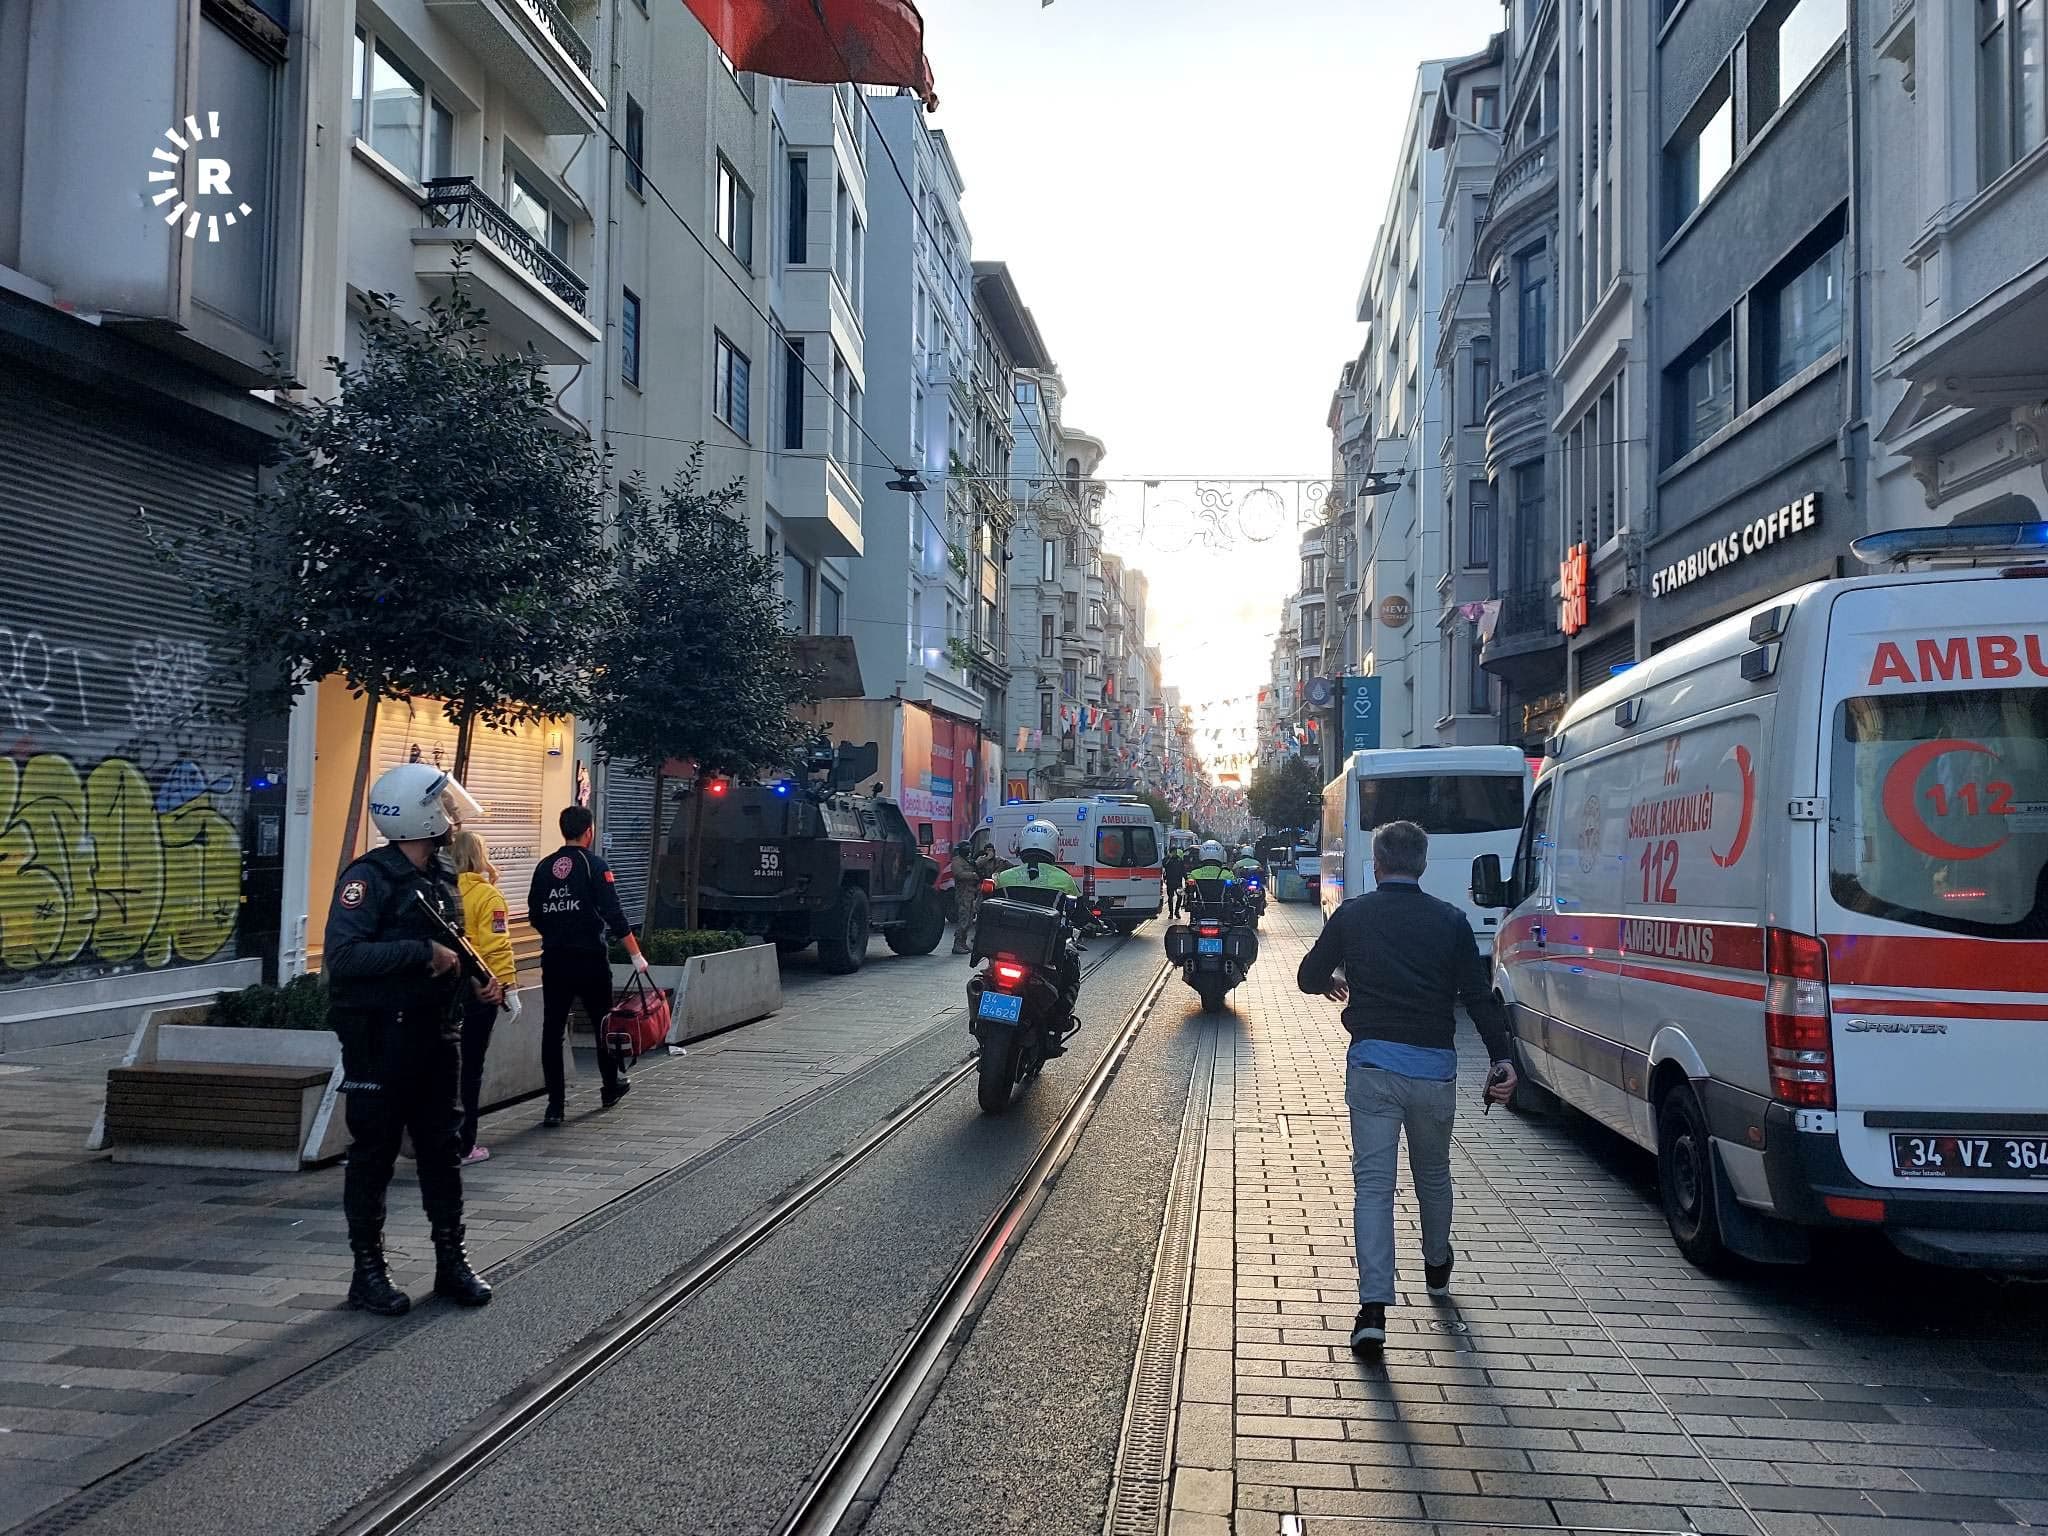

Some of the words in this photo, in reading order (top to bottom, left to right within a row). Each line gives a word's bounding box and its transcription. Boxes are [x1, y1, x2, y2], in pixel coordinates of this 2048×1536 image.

[1652, 531, 1739, 599] STARBUCKS
[1743, 492, 1815, 554] COFFEE
[1629, 798, 1660, 839] SAĞLIK
[1660, 785, 1714, 836] BAKANLIĞI
[1926, 780, 2016, 816] 112
[761, 853, 779, 869] 59
[1640, 839, 1679, 904] 112
[1622, 919, 1713, 963] AMBULANS
[984, 993, 998, 1004] 34
[1010, 998, 1017, 1007] A
[1910, 1138, 1942, 1166] 34
[1957, 1139, 1992, 1168] VZ
